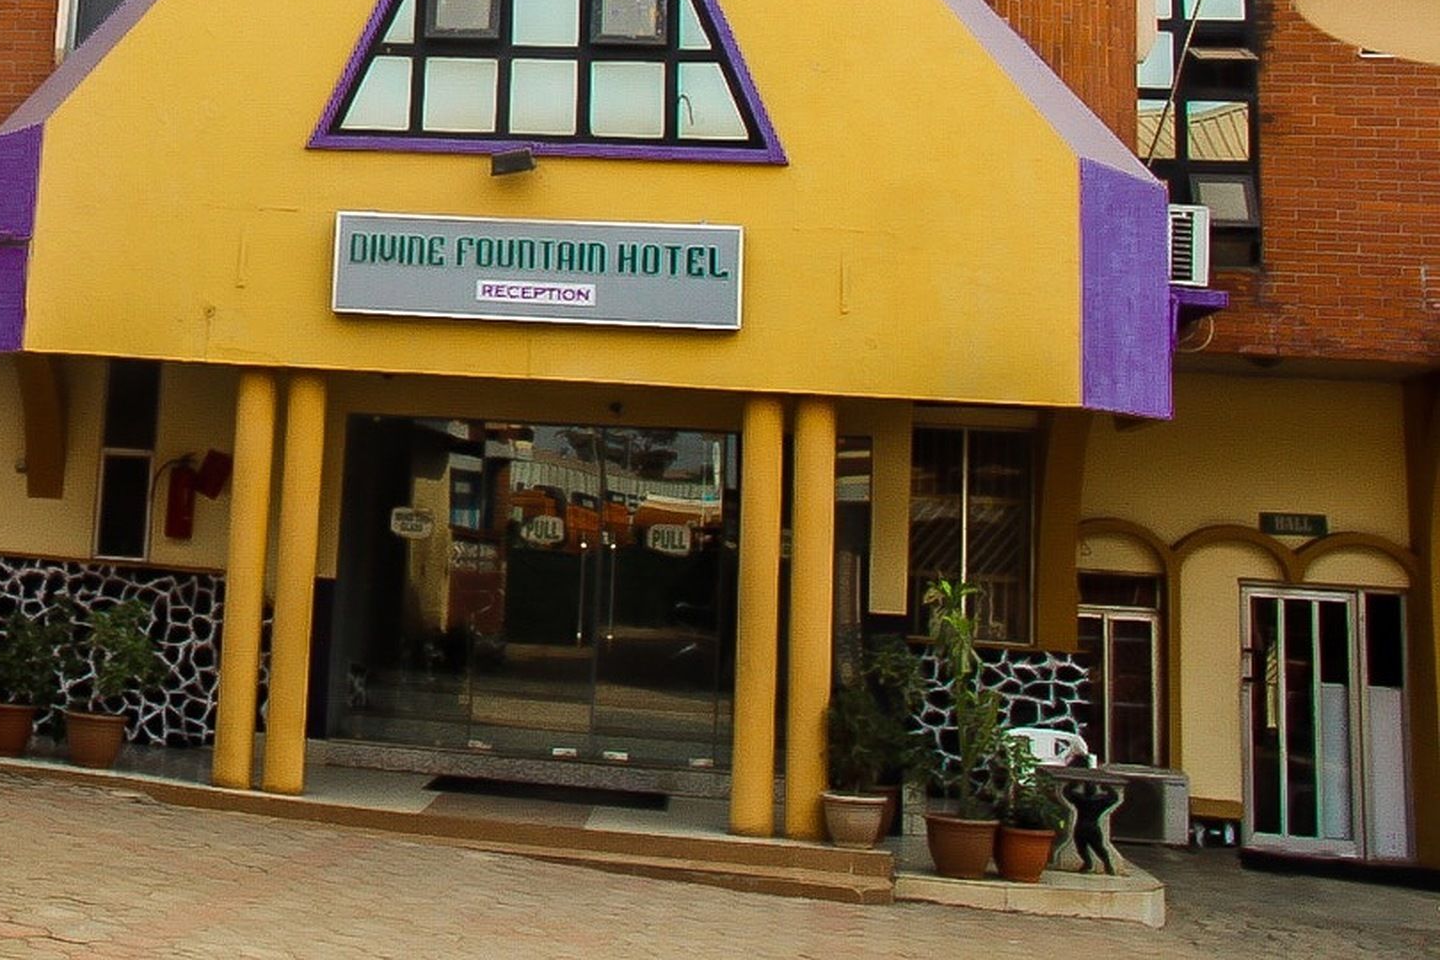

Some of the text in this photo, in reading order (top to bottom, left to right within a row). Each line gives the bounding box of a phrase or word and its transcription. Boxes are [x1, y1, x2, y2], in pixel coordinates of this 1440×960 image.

[349, 232, 730, 280] DIVINE FOUNTAIN HOTEL
[481, 284, 590, 302] RECEPTION
[525, 516, 561, 541] PULL
[1275, 516, 1312, 531] HALL
[652, 528, 688, 550] PULL
